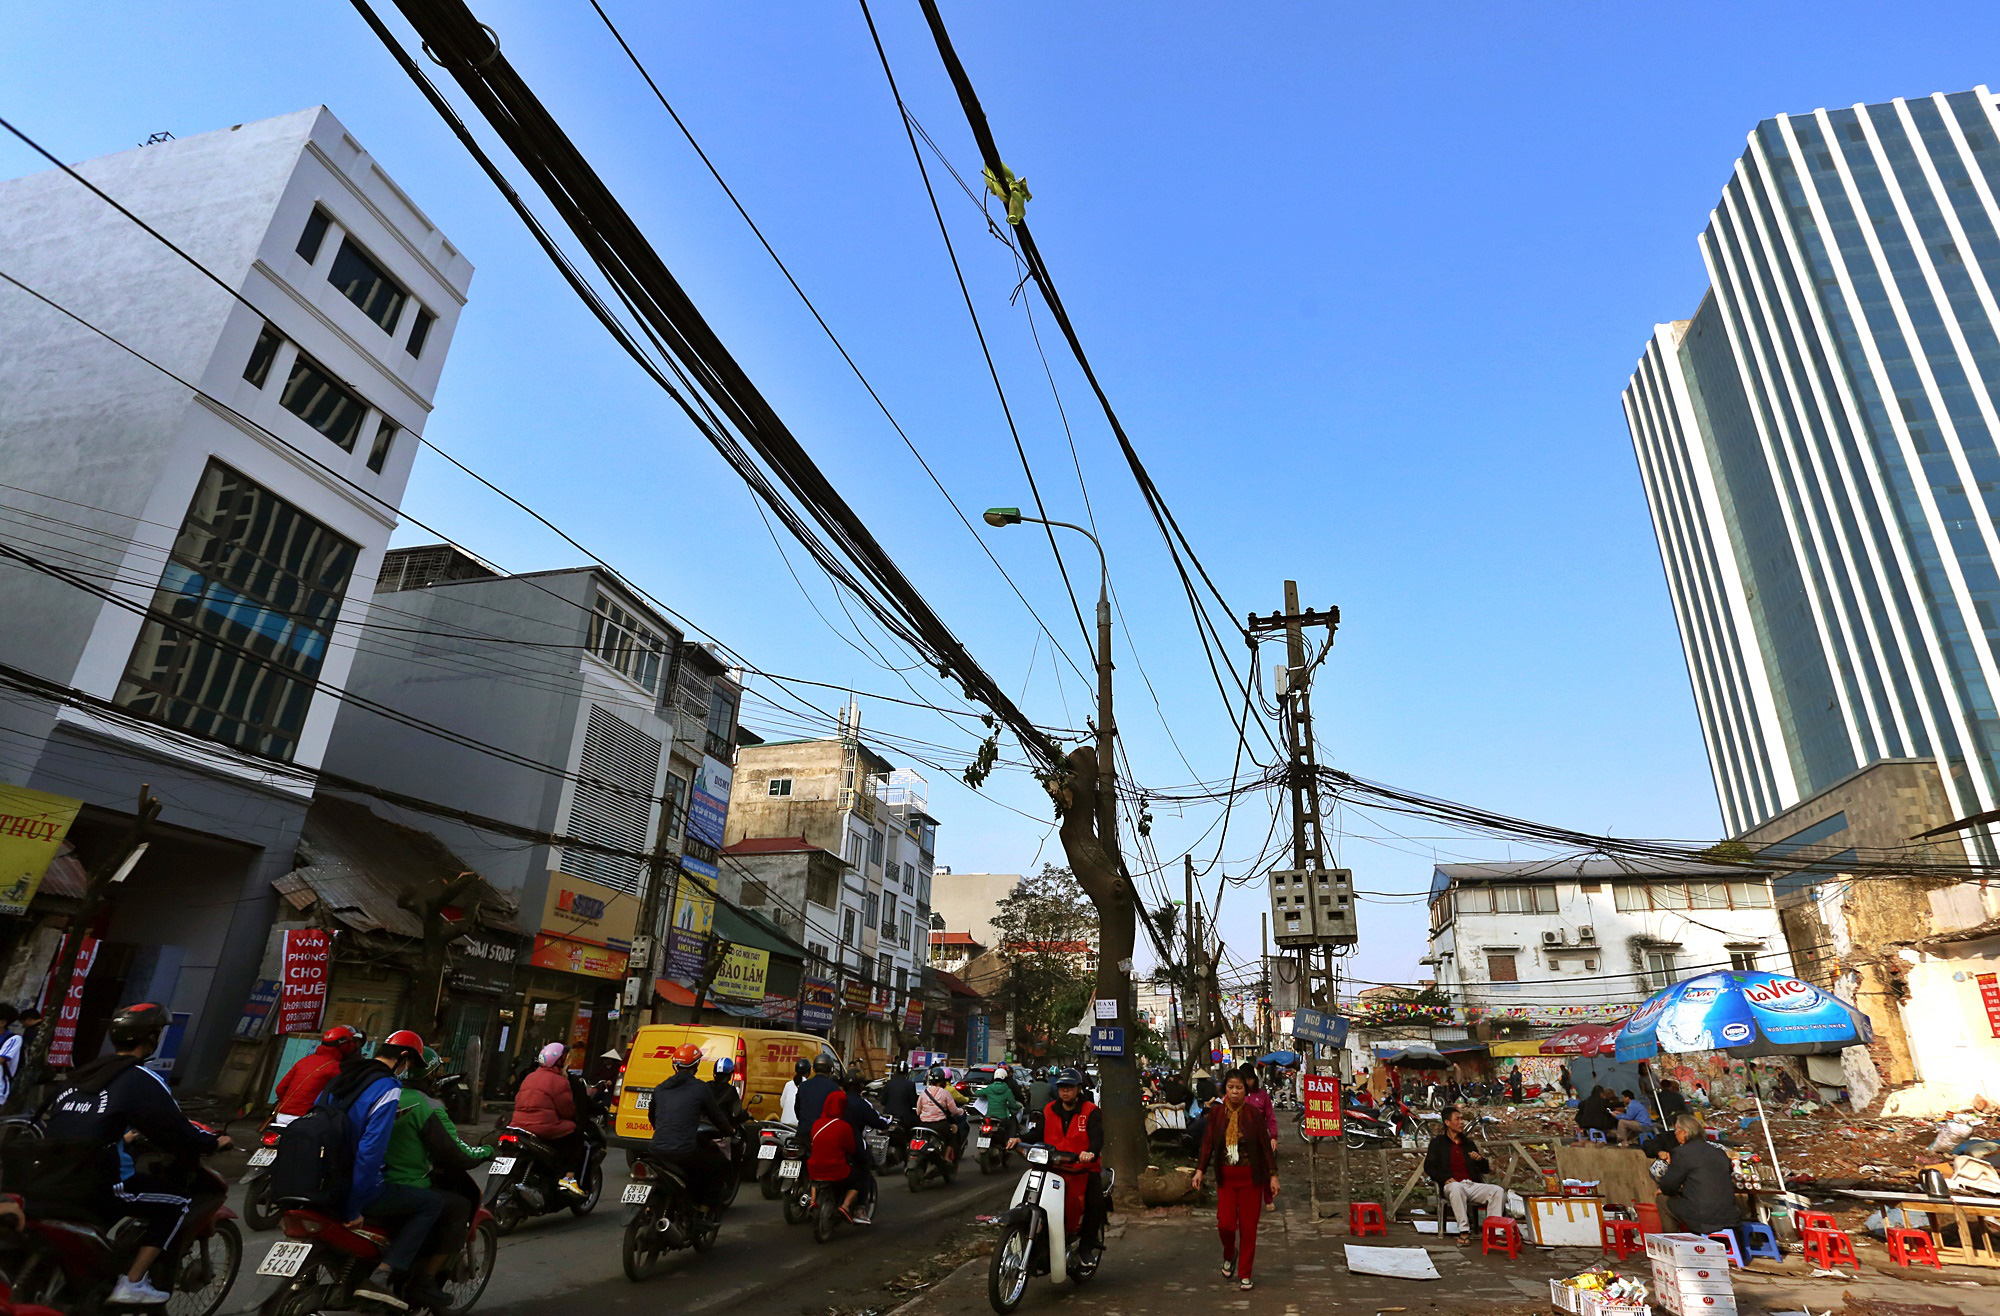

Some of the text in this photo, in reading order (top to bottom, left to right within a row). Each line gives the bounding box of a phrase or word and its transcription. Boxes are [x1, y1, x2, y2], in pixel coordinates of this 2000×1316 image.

[489, 944, 516, 962] STORE
[290, 967, 322, 978] CHO
[718, 957, 740, 979] BẢO
[743, 963, 764, 983] LÂM
[285, 981, 326, 995] THUÊ
[1326, 1019, 1336, 1030] 13
[767, 1044, 801, 1062] DHL
[1308, 1079, 1333, 1093] BÁN
[1309, 1099, 1320, 1111] SIM
[273, 1244, 305, 1259] 38-P1
[264, 1259, 296, 1273] 5420
